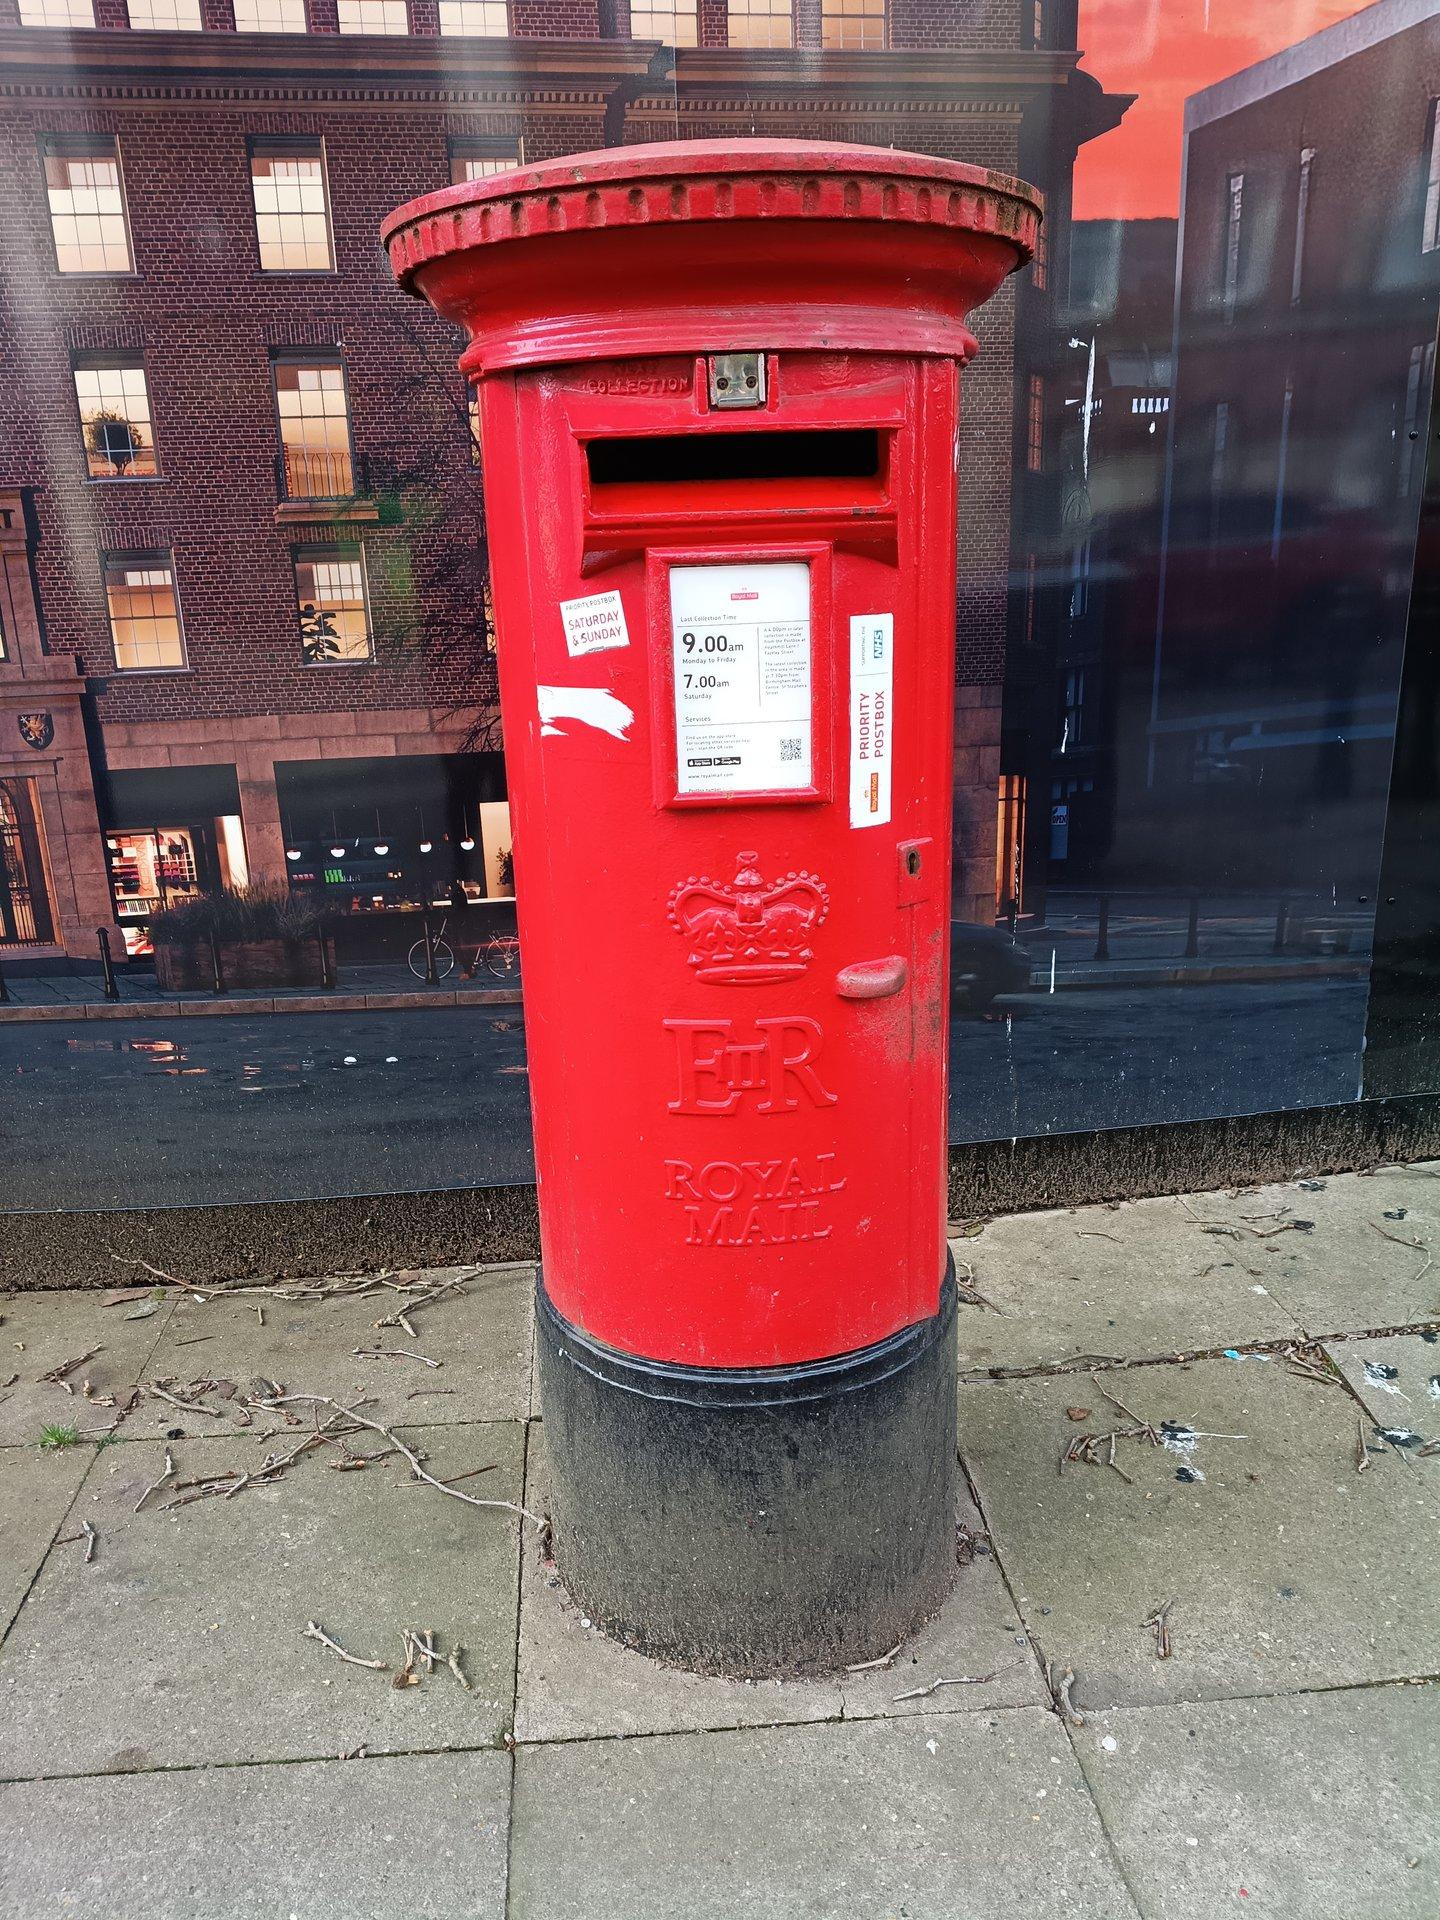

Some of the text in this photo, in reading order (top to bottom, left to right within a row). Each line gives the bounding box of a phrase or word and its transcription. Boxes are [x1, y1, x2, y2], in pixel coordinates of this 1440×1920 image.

[588, 377, 688, 394] COLLECTION
[590, 595, 616, 606] POSTBOX
[568, 610, 619, 631] SATURDAY
[572, 626, 622, 647] & SUNDAY
[682, 632, 744, 654] 9.00am
[874, 630, 883, 658] NHS
[683, 674, 730, 689] 7.00am
[860, 693, 870, 760] PRIORITY
[874, 691, 885, 758] POSTBOX
[664, 1153, 847, 1201] ROYAL
[684, 1201, 834, 1247] MAIL
